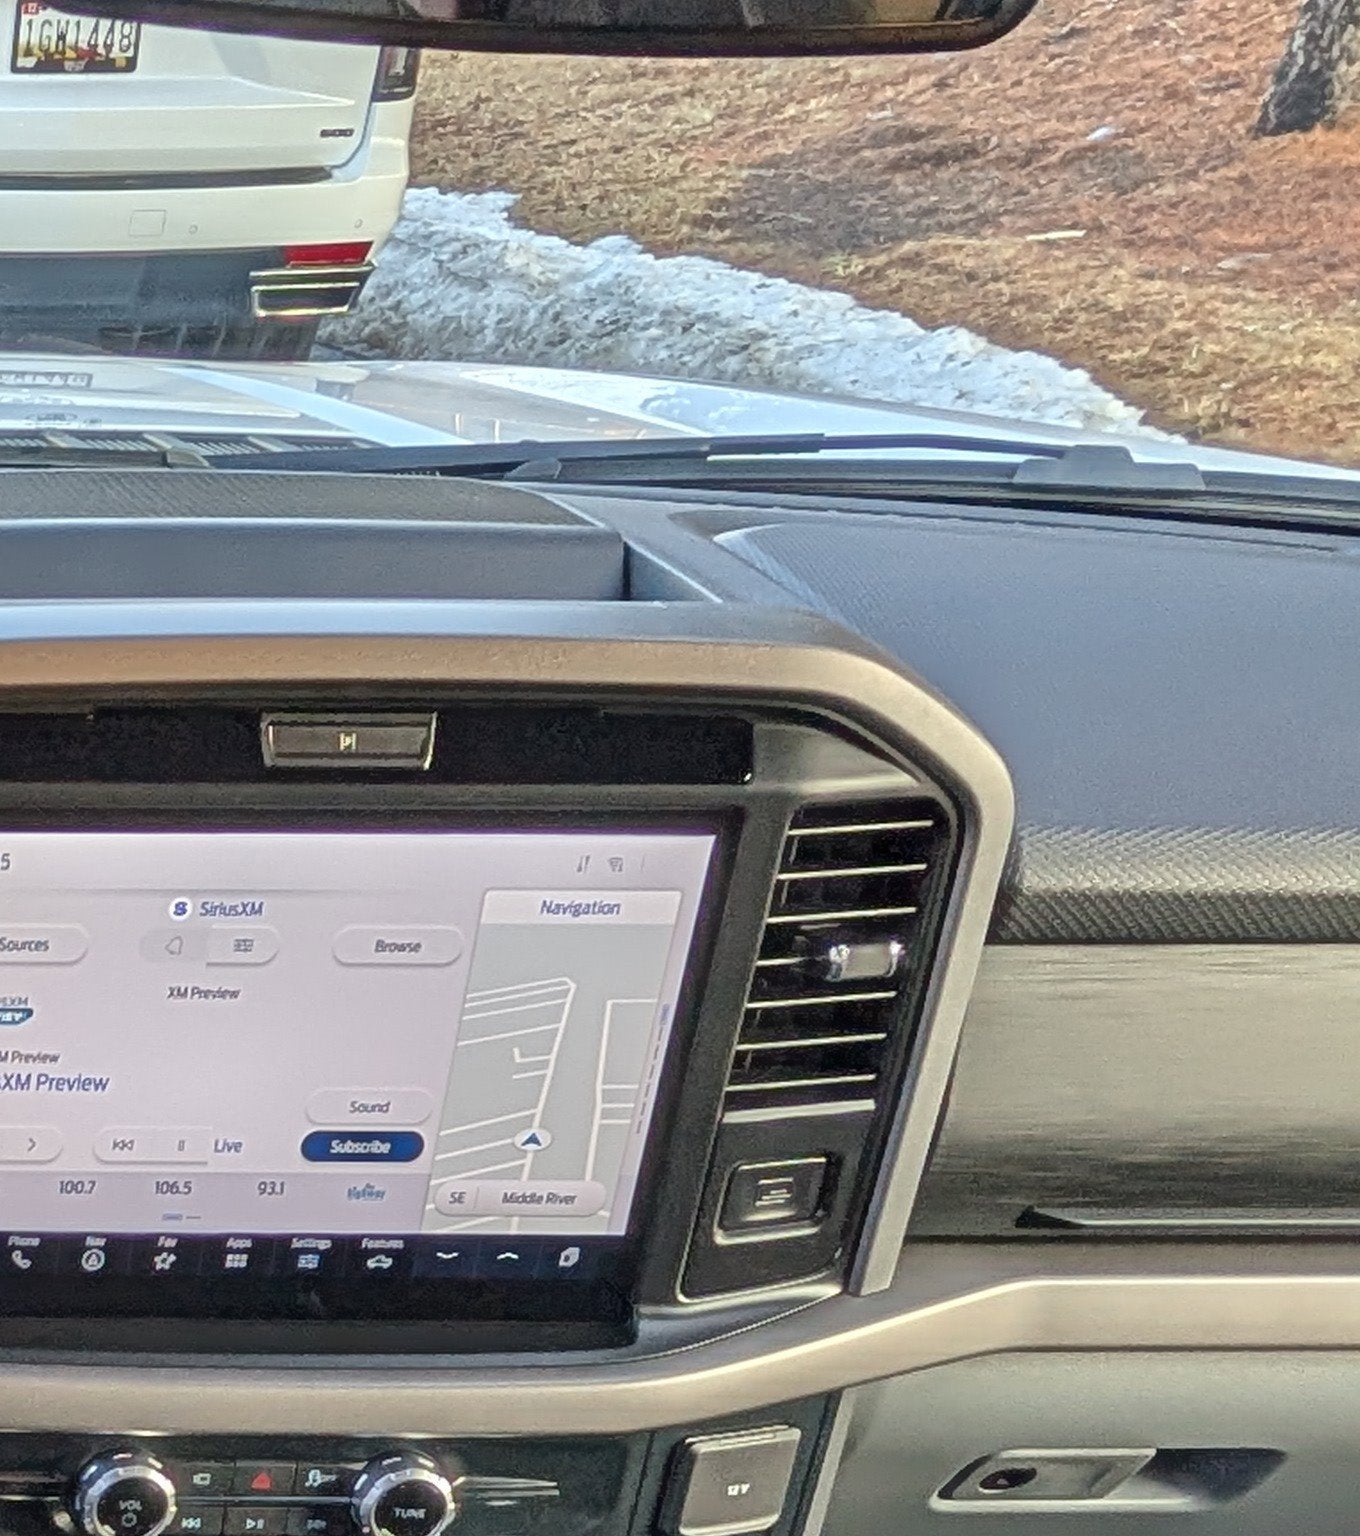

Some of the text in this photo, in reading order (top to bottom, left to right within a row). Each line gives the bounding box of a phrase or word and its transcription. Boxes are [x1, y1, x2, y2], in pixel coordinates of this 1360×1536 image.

[199, 901, 264, 917] SiriusXM
[540, 899, 621, 917] Navigation
[375, 939, 422, 953] Browse
[167, 986, 240, 1000] XM Preview
[11, 1050, 60, 1064] Preview
[36, 1073, 109, 1092] Preview
[349, 1101, 391, 1114] Sound
[214, 1139, 243, 1153] Live
[330, 1140, 392, 1154] Subscribe
[59, 1180, 96, 1194] 100.7
[155, 1180, 192, 1194] 106.5
[258, 1181, 285, 1196] 93.1
[449, 1192, 466, 1205] SE
[502, 1191, 578, 1205] Middle River
[8, 1236, 41, 1247] Phone
[226, 1237, 253, 1250] Apps
[119, 1500, 143, 1511] VOL
[394, 1507, 427, 1520] TUNE
